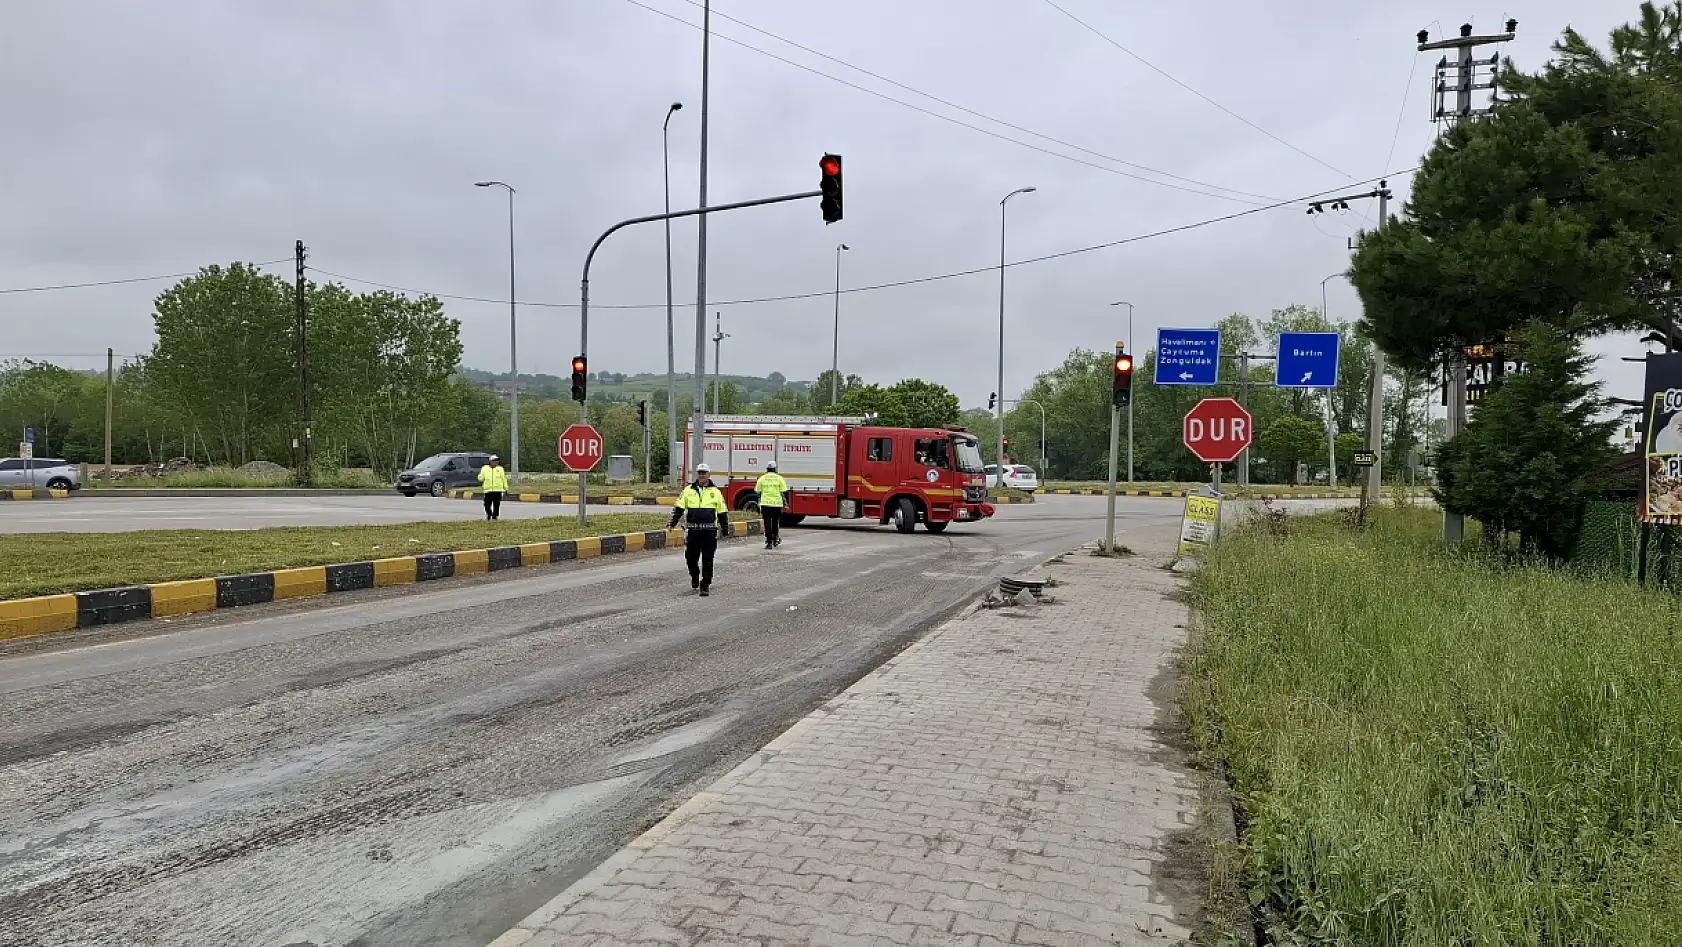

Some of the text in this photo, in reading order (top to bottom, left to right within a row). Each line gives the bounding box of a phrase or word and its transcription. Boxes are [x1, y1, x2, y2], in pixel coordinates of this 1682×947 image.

[1161, 347, 1204, 356] Çaycuma
[1293, 348, 1323, 357] Bartın
[1160, 356, 1212, 366] Zonguldak
[1189, 417, 1245, 442] DUR
[562, 438, 599, 457] DUR
[1189, 504, 1215, 516] CLASS
